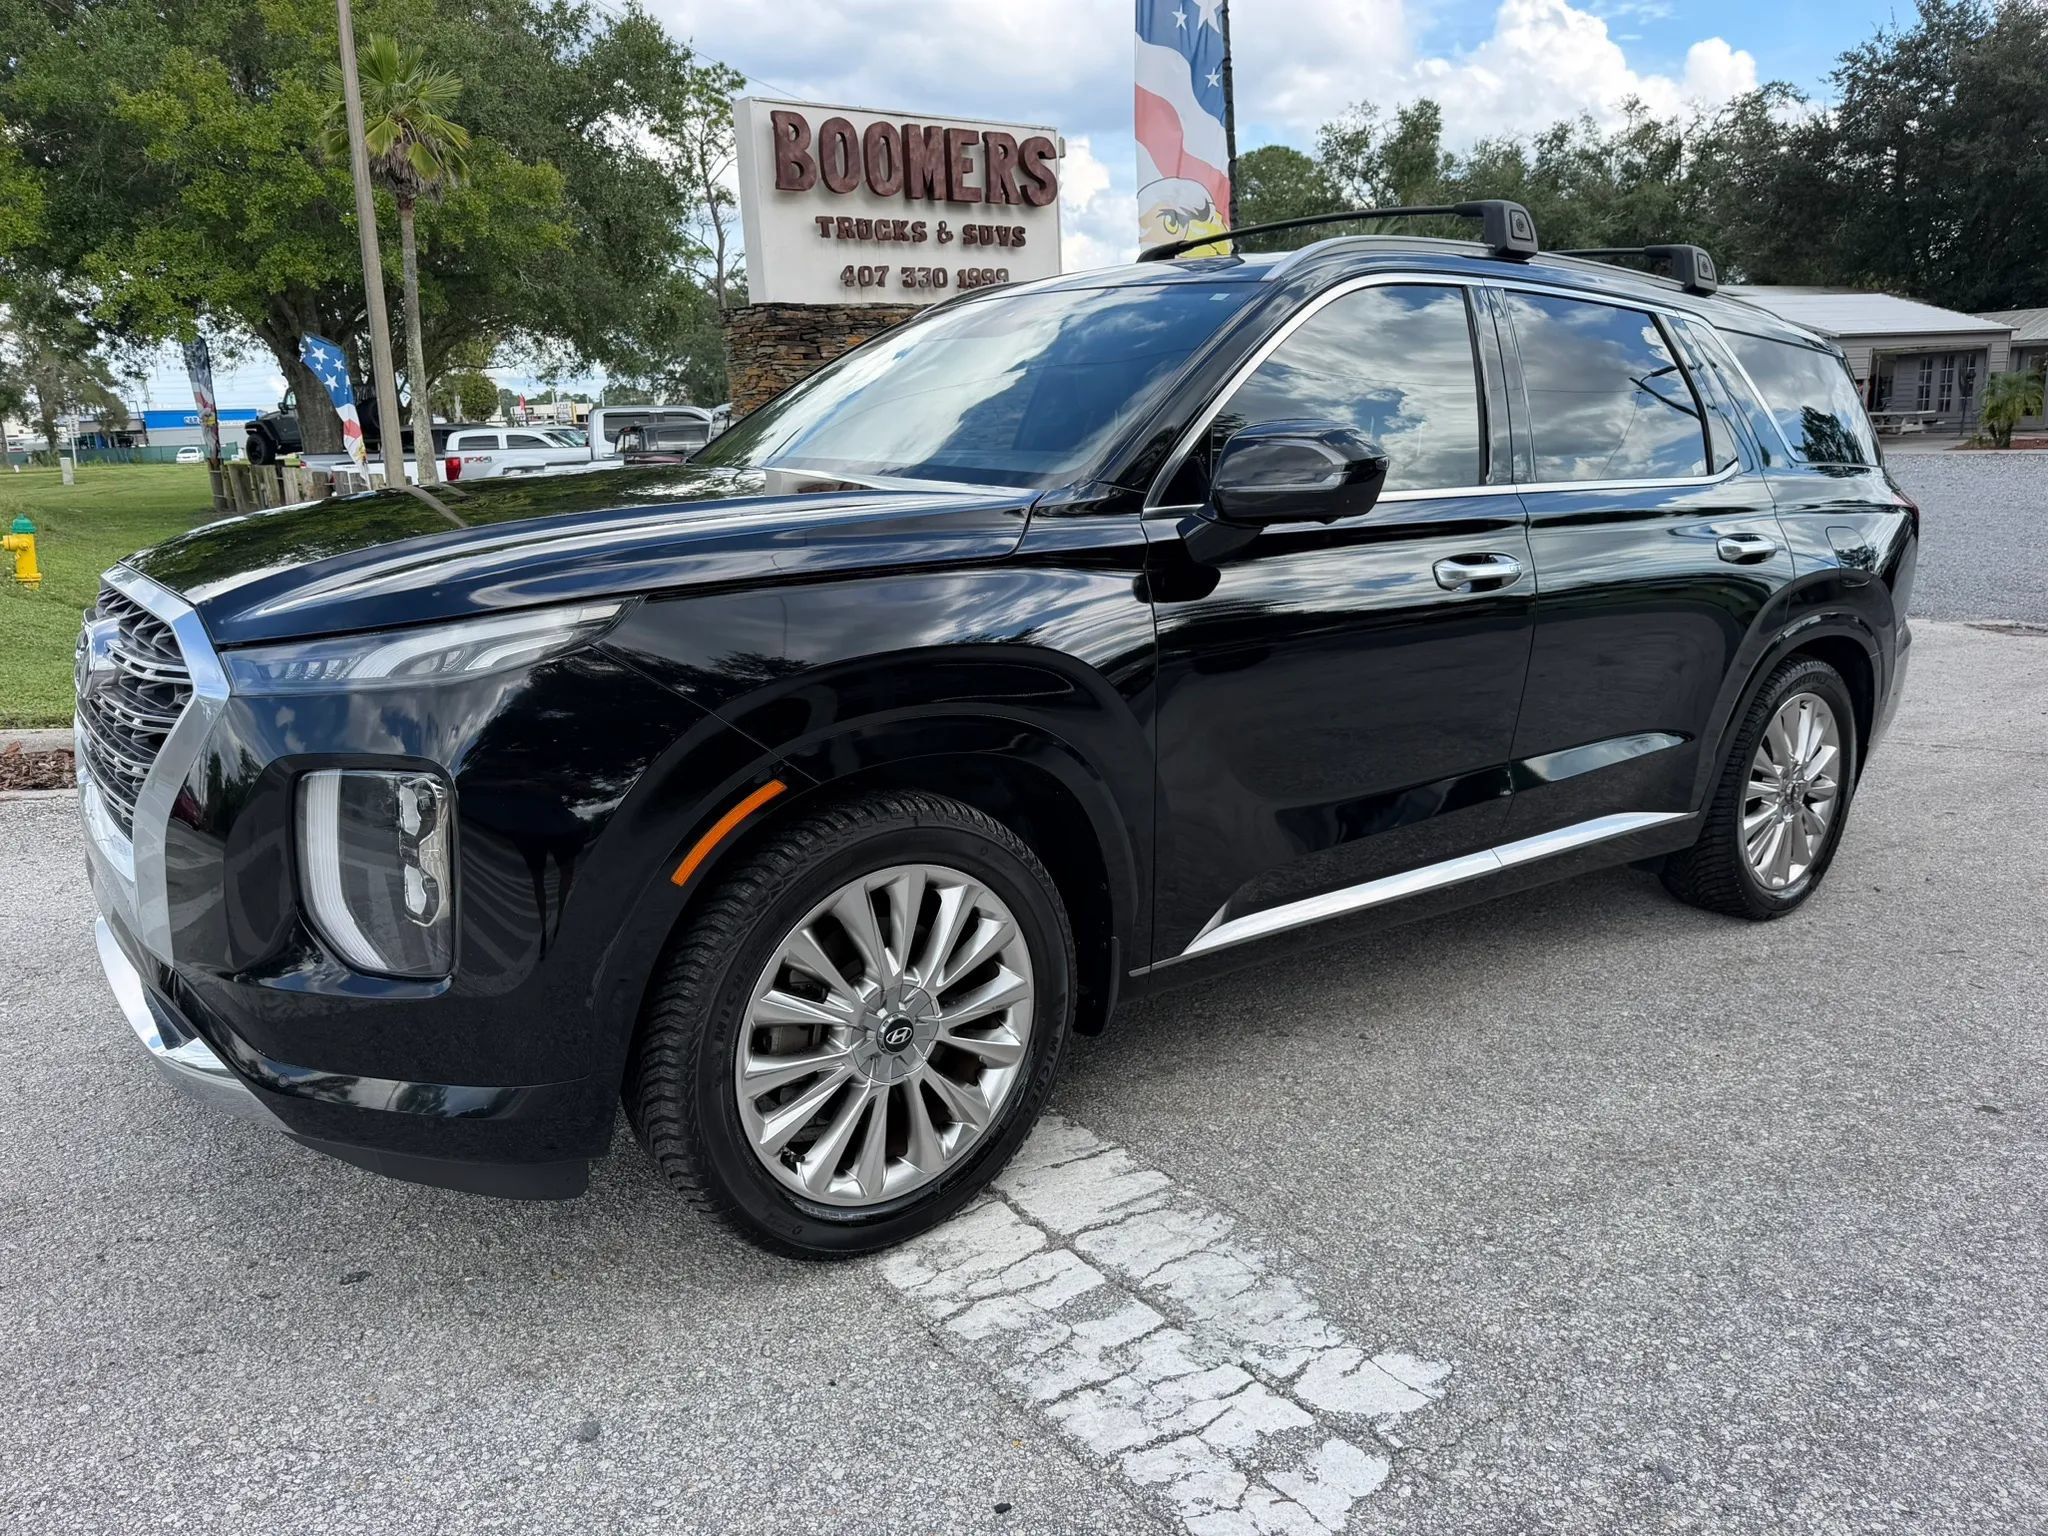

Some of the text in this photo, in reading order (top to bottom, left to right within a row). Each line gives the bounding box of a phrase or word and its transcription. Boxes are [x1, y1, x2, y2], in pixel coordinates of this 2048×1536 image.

[771, 110, 1057, 207] BOOMERS
[815, 216, 1026, 247] TRUCKS & SUVS
[840, 265, 1009, 289] 407 330 1999
